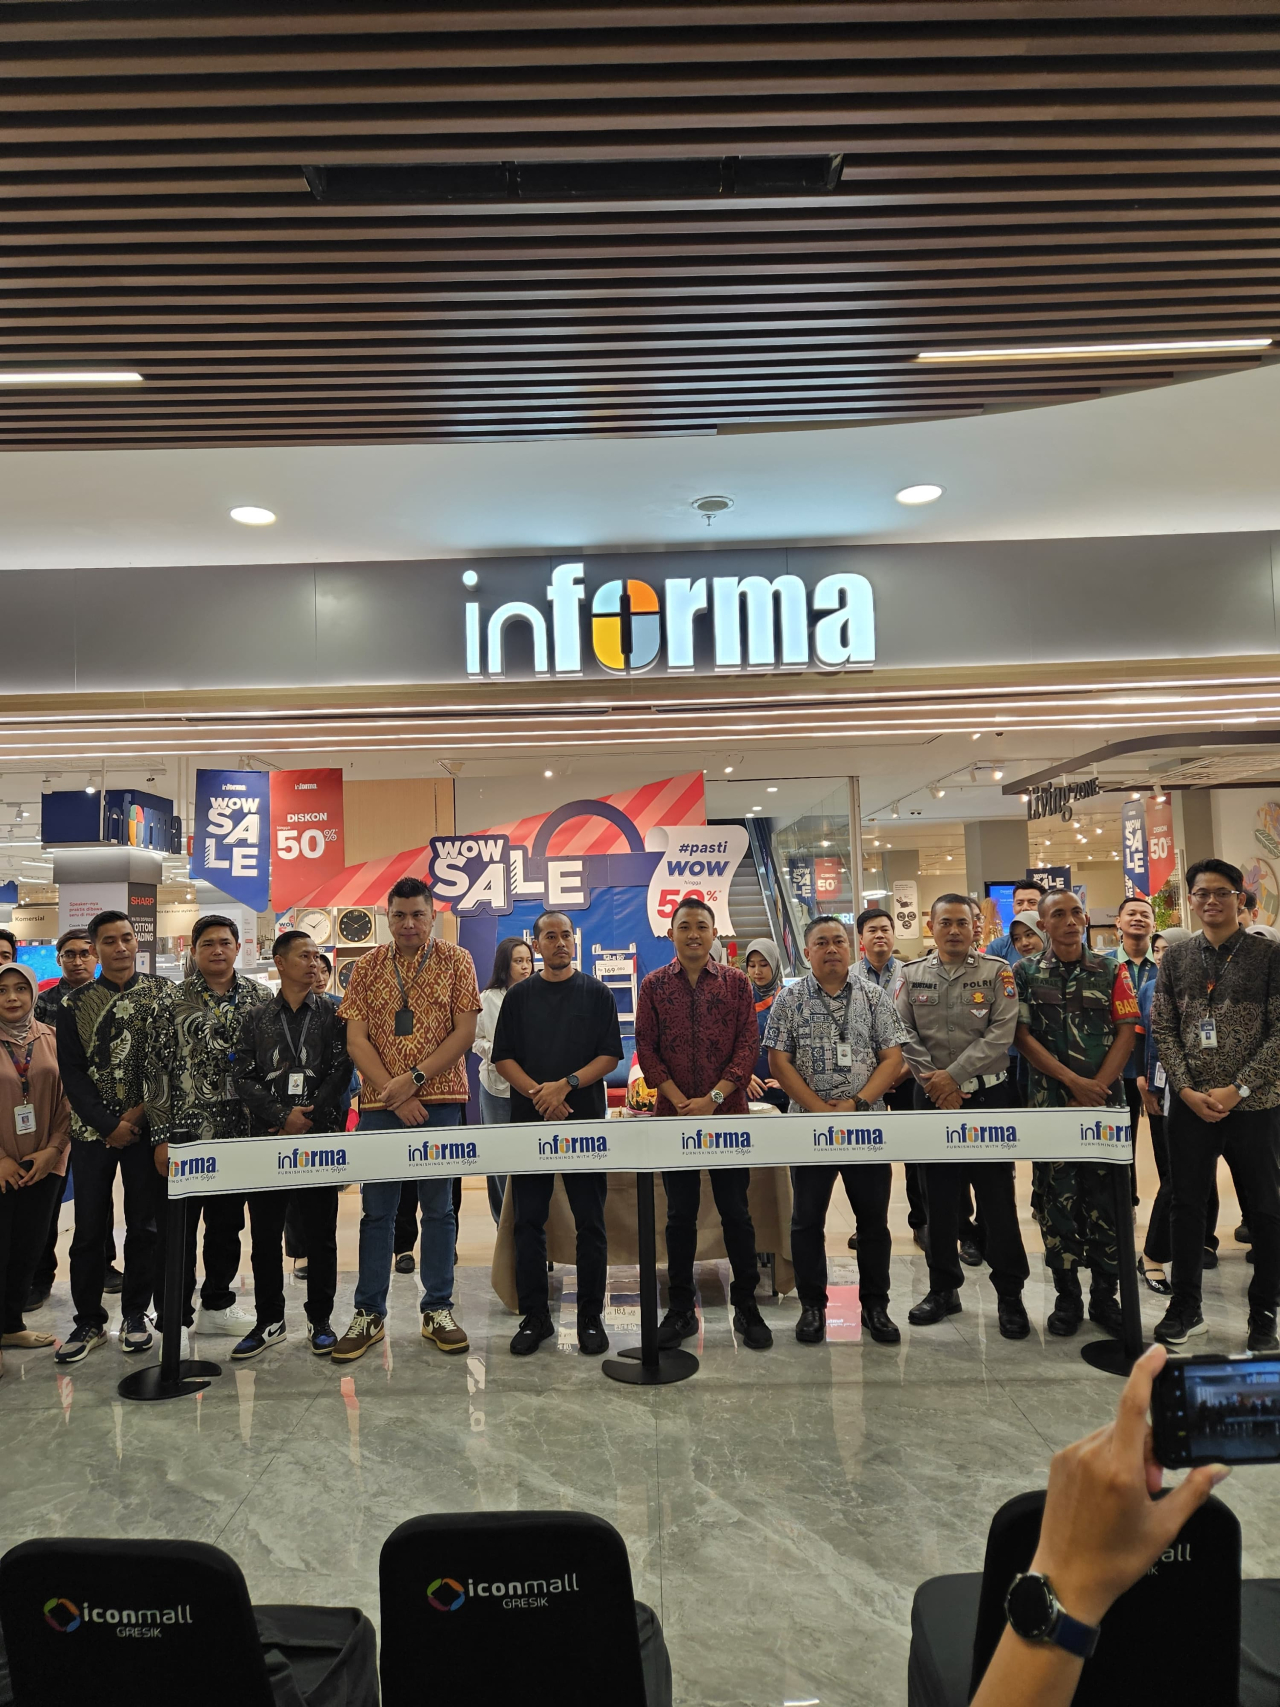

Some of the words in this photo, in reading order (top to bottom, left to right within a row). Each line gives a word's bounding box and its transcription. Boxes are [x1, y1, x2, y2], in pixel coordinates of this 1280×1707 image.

[462, 563, 876, 676] informa
[210, 797, 260, 813] WOW
[1027, 781, 1073, 823] Living
[1074, 776, 1100, 802] ZONE
[104, 792, 182, 854] informa
[287, 813, 328, 823] DISKON
[1126, 819, 1142, 829] WOW
[436, 840, 504, 861] WOW
[678, 841, 728, 856] #pasti
[667, 861, 731, 877] WOW
[433, 850, 584, 910] SALE
[131, 896, 155, 906] SHARP
[132, 922, 154, 932] OTTOM
[963, 980, 992, 989] POLRI
[682, 1129, 751, 1149] informa
[813, 1126, 883, 1146] informa
[946, 1123, 1017, 1143] informa
[408, 1141, 477, 1161] informa
[538, 1135, 607, 1154] informa
[1001, 1142, 1017, 1150] Style
[278, 1148, 347, 1169] informa
[462, 1158, 477, 1166] Style
[468, 1573, 579, 1597] iconmall
[503, 1597, 549, 1608] GRESIK
[83, 1602, 193, 1624] iconmall
[117, 1627, 162, 1638] GRESIK
